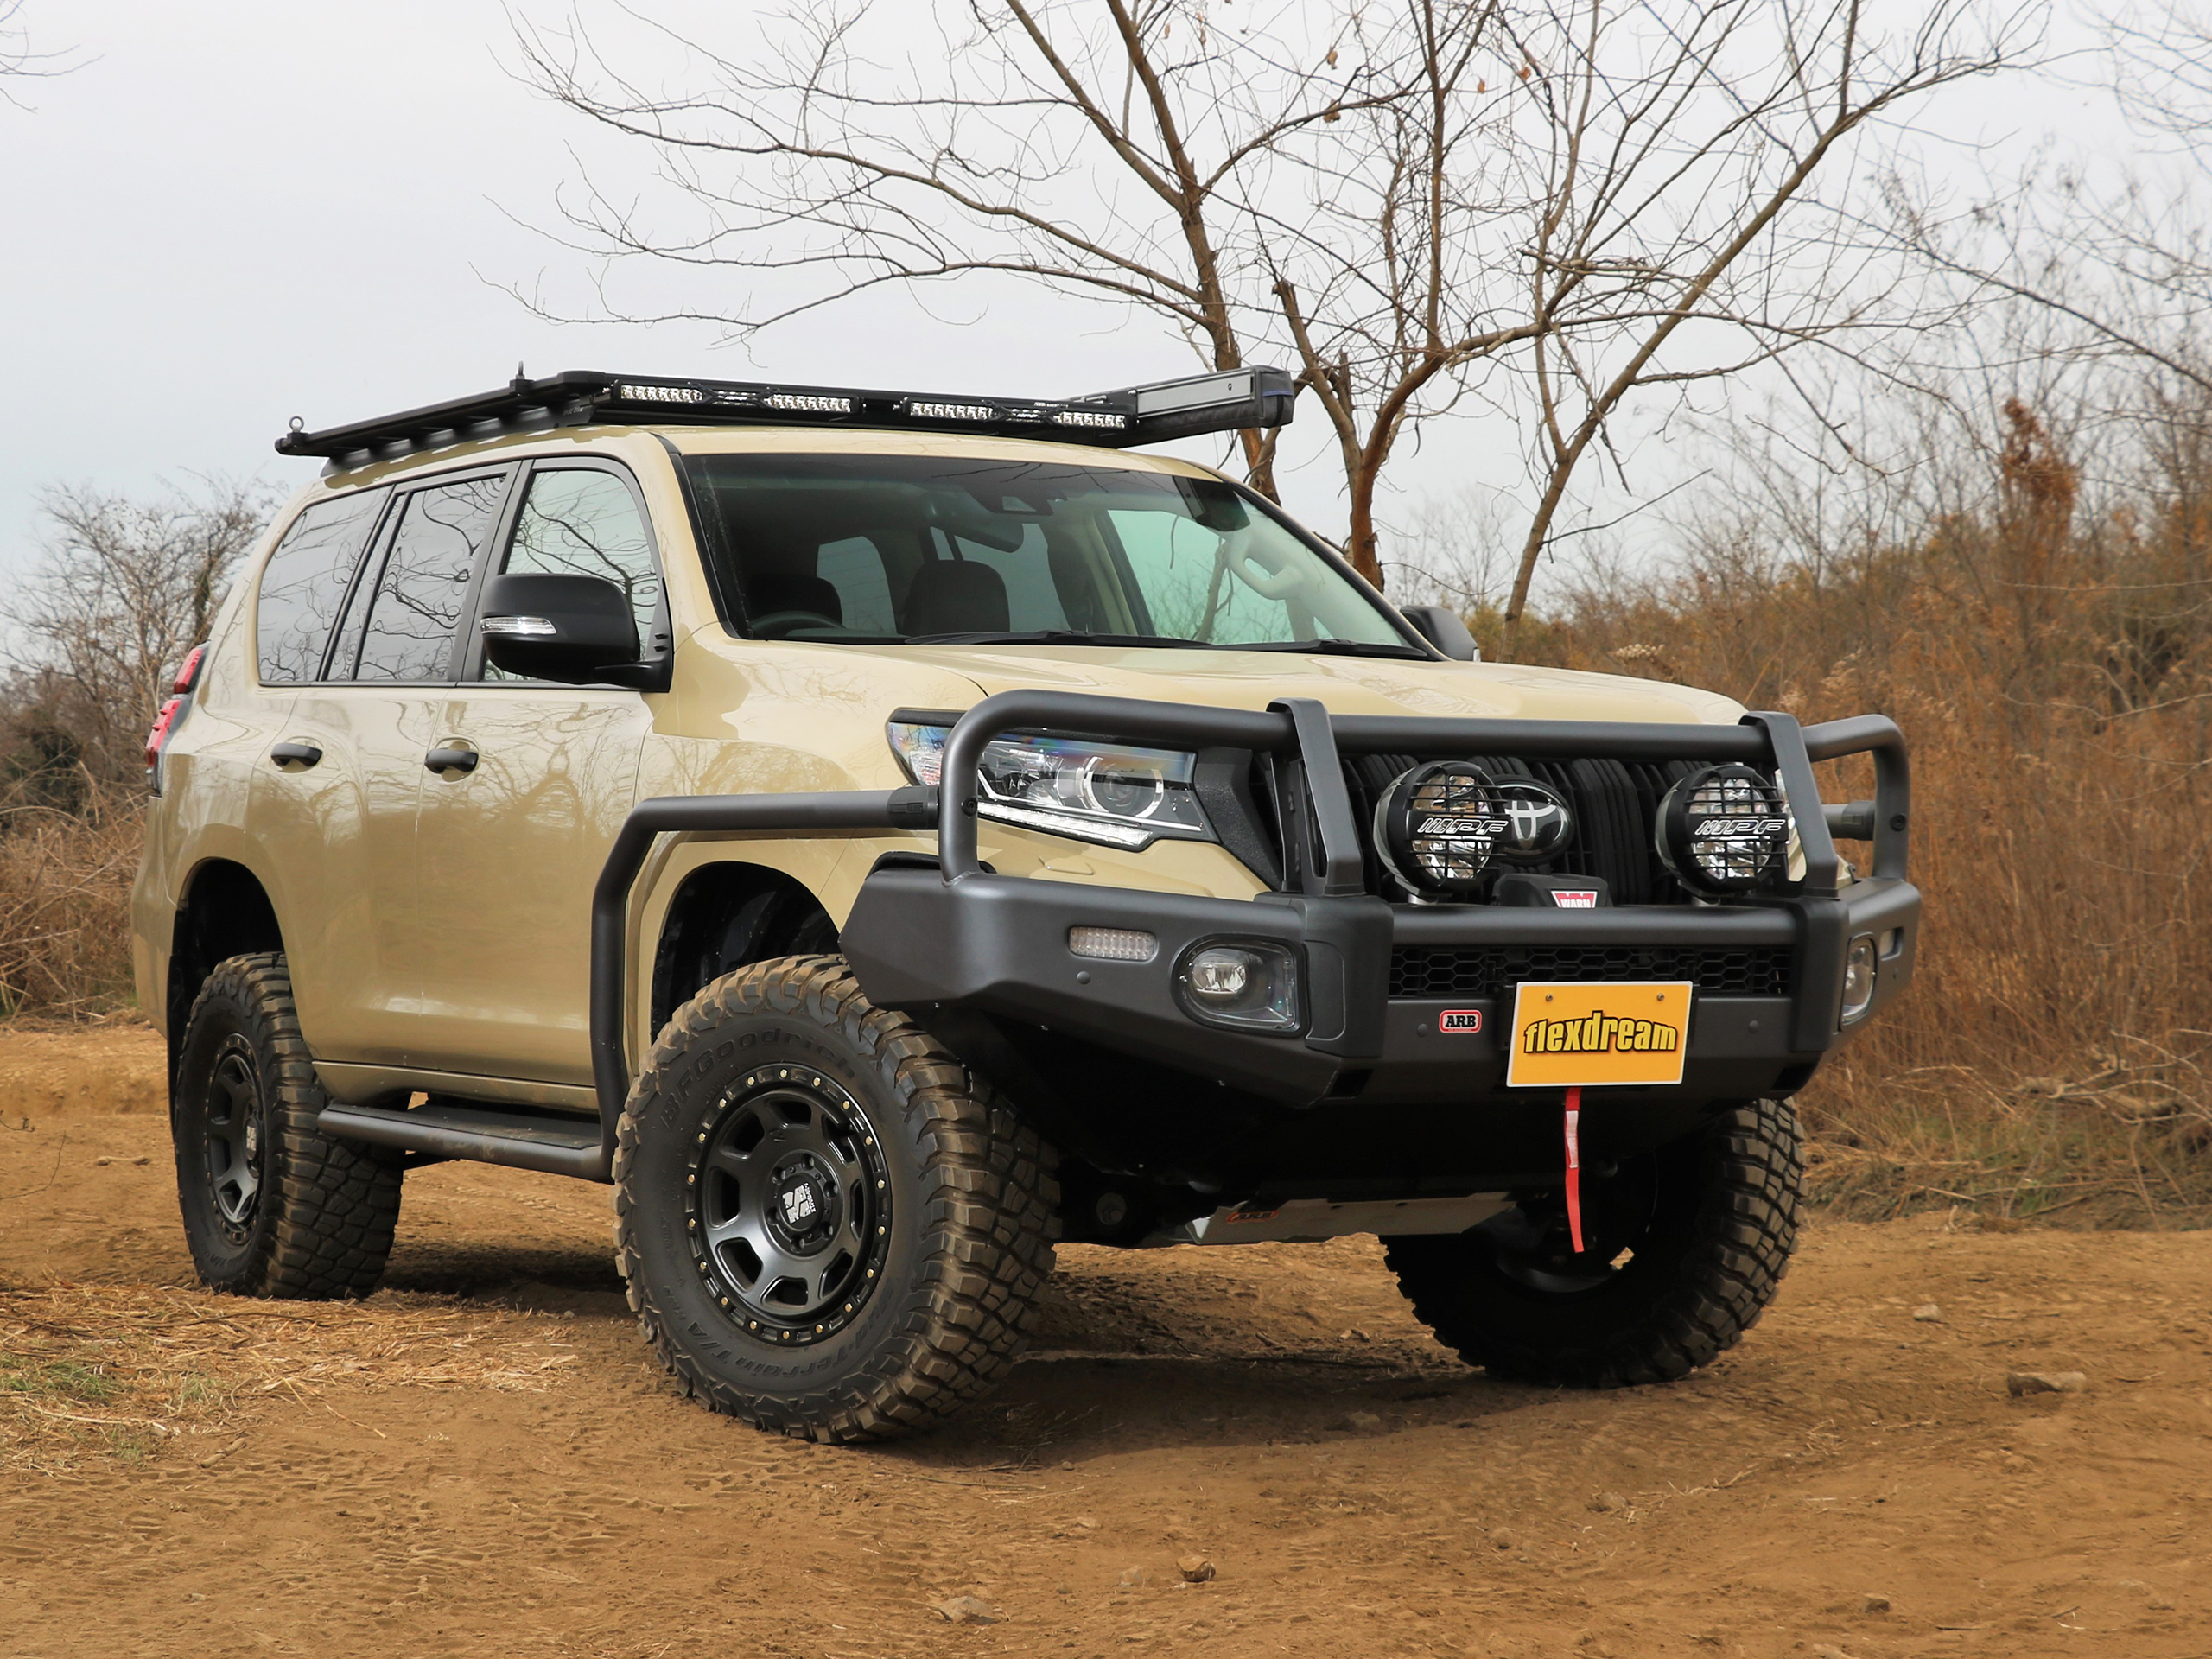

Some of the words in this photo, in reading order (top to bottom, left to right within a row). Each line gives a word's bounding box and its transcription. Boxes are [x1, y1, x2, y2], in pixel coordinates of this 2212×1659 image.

[1560, 899, 1592, 908] WARN
[1445, 1015, 1477, 1027] ARB
[1523, 1010, 1678, 1054] flexdream
[660, 1027, 855, 1130] BFGoodrich
